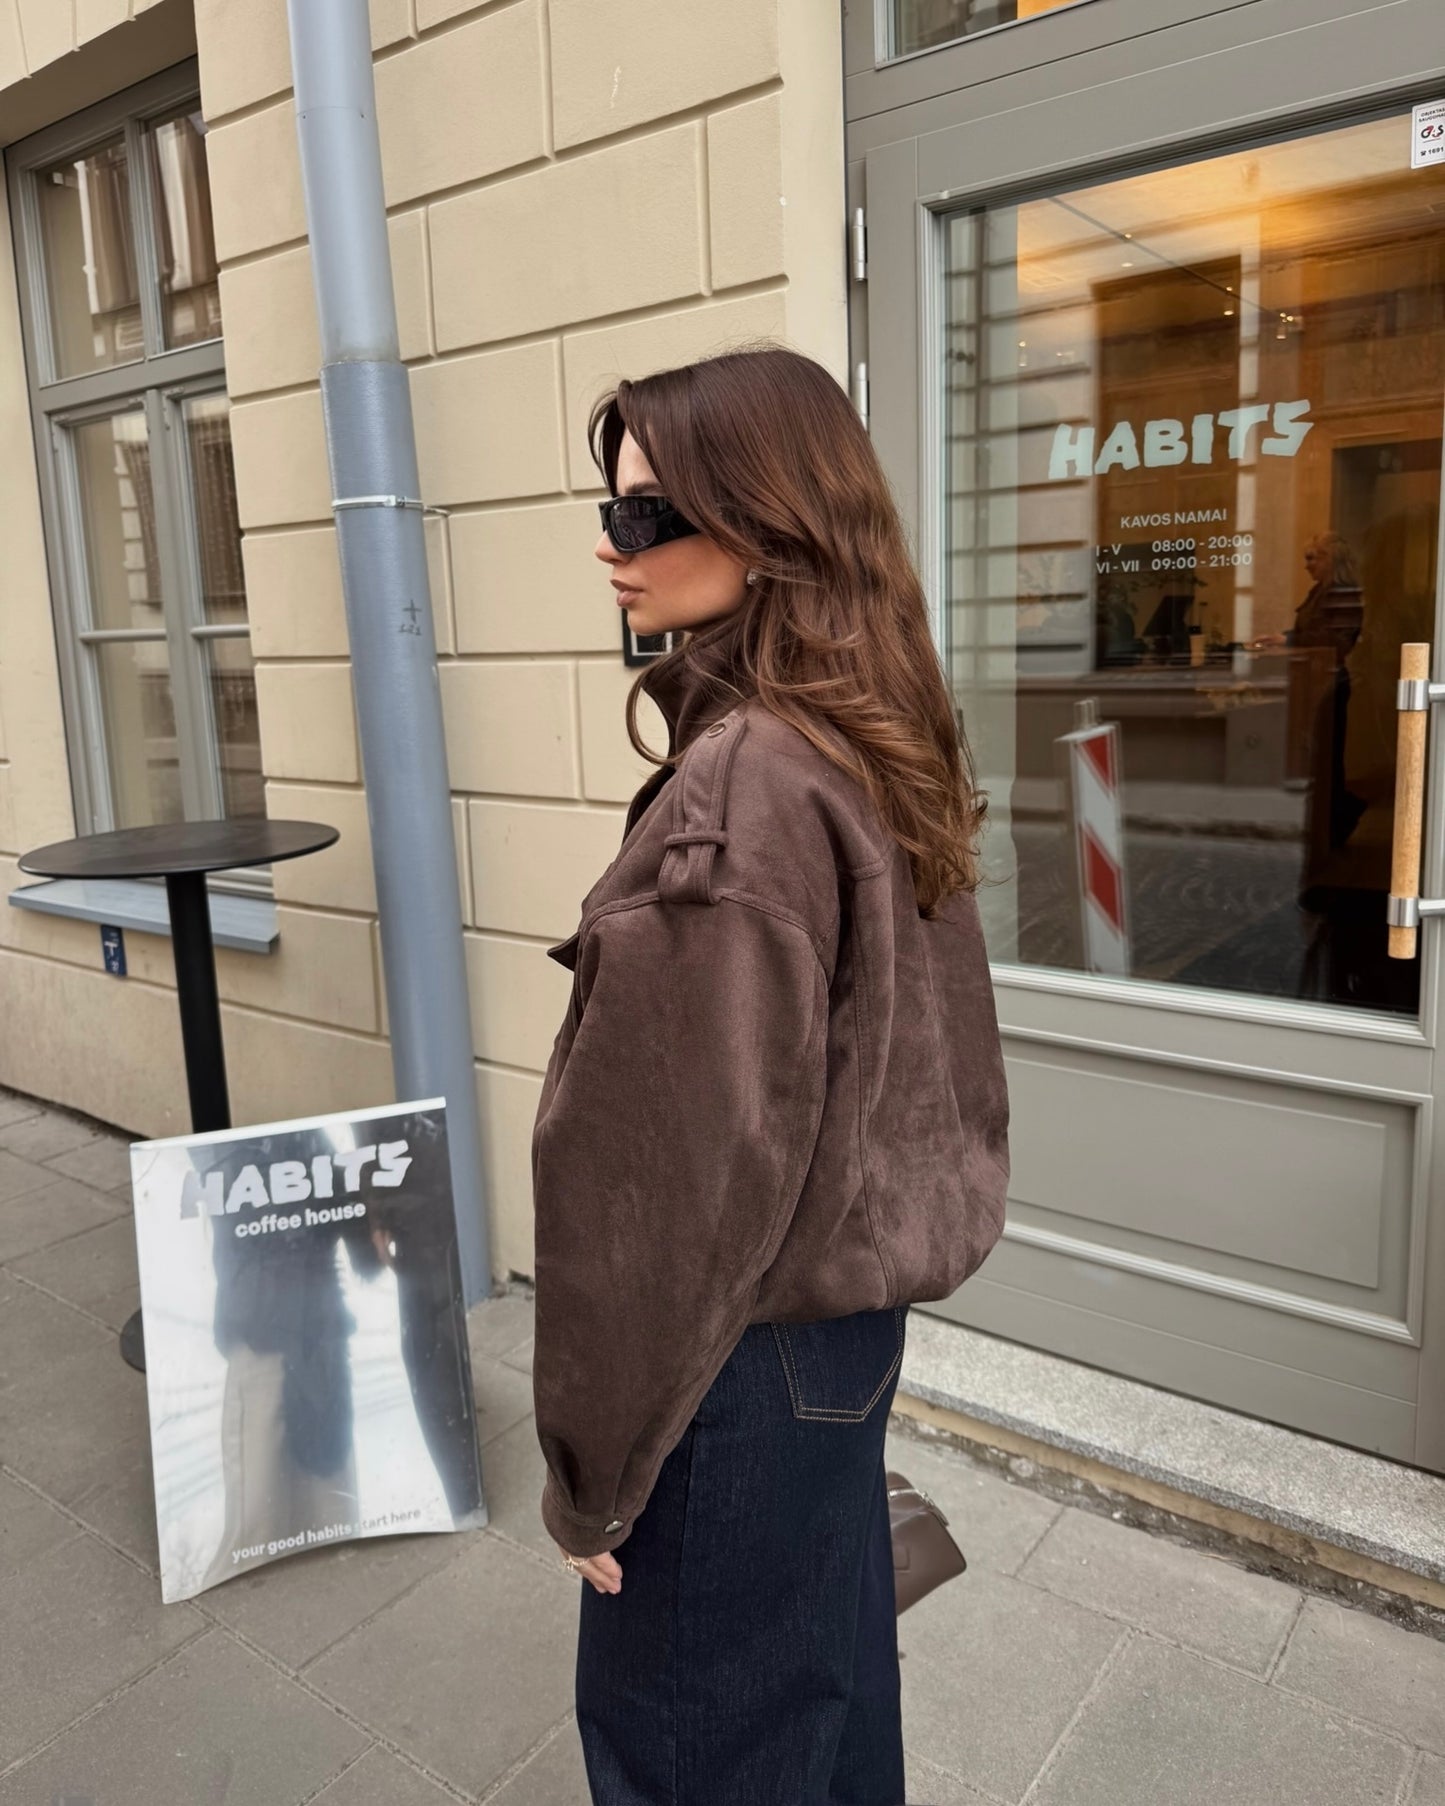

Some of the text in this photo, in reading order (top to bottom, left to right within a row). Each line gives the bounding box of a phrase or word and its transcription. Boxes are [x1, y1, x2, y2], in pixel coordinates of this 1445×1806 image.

[1048, 399, 1315, 480] HABITS
[1120, 508, 1227, 529] KAVOS NAMAI
[1151, 537, 1196, 553] 08:00
[1207, 534, 1253, 549] 20:00
[1096, 562, 1110, 574] VI
[1121, 560, 1140, 573] VII
[1151, 556, 1197, 571] 09:00
[1208, 552, 1253, 567] 21:00
[180, 1139, 413, 1221] HABITS
[234, 1202, 367, 1238] coffee house
[231, 1543, 266, 1564] your
[267, 1530, 305, 1556] good
[306, 1521, 352, 1544] habits
[390, 1507, 422, 1525] here
